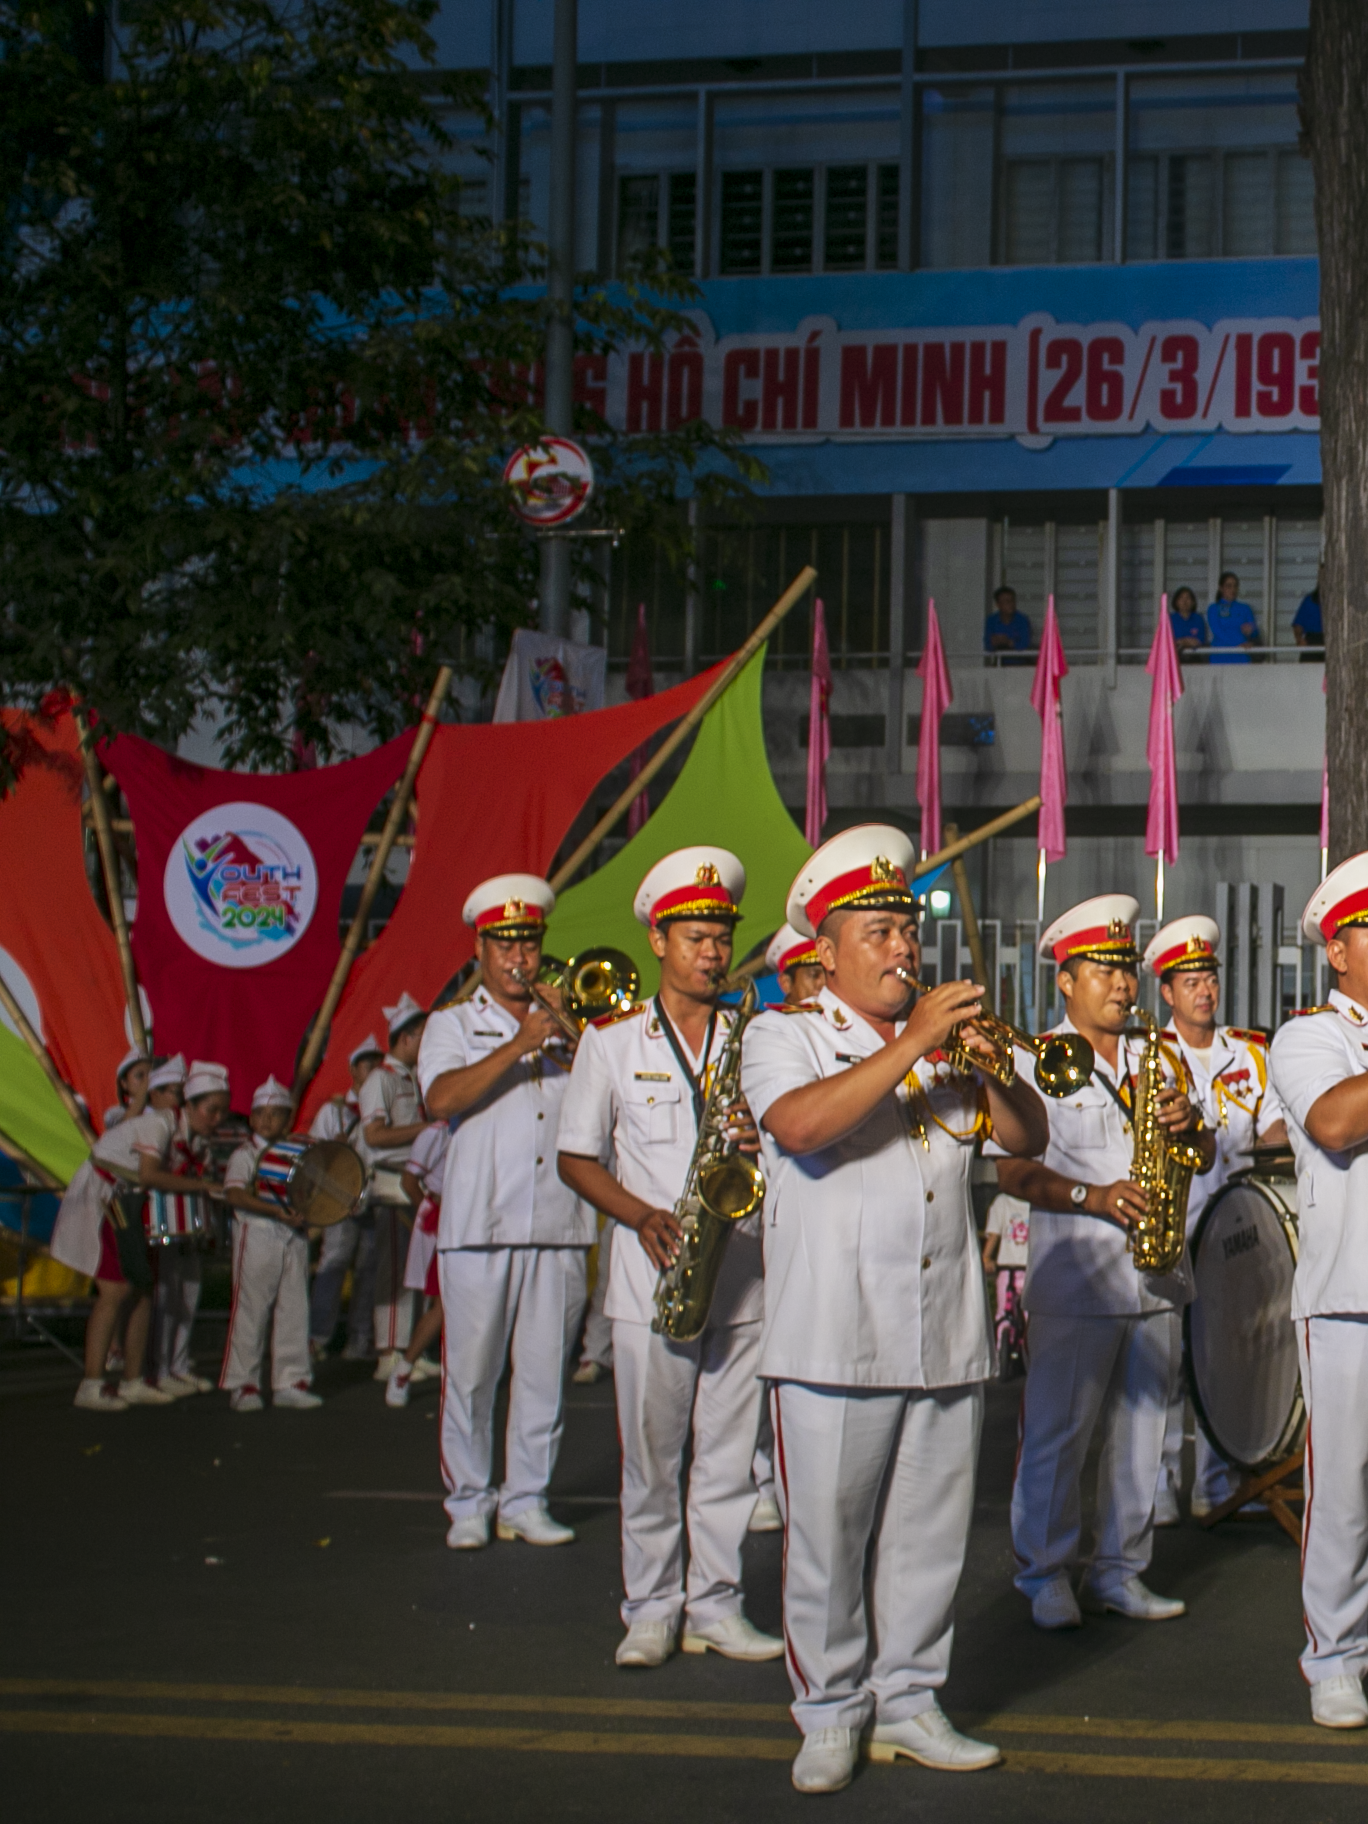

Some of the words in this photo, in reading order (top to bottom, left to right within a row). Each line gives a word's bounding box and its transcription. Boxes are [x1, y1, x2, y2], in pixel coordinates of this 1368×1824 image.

[723, 330, 821, 432] CHÍ
[839, 340, 1007, 427] MINH
[1027, 327, 1321, 433] (26/3/193
[221, 882, 302, 902] FEST
[221, 905, 286, 929] 2024
[1221, 1223, 1260, 1261] YAMAHA
